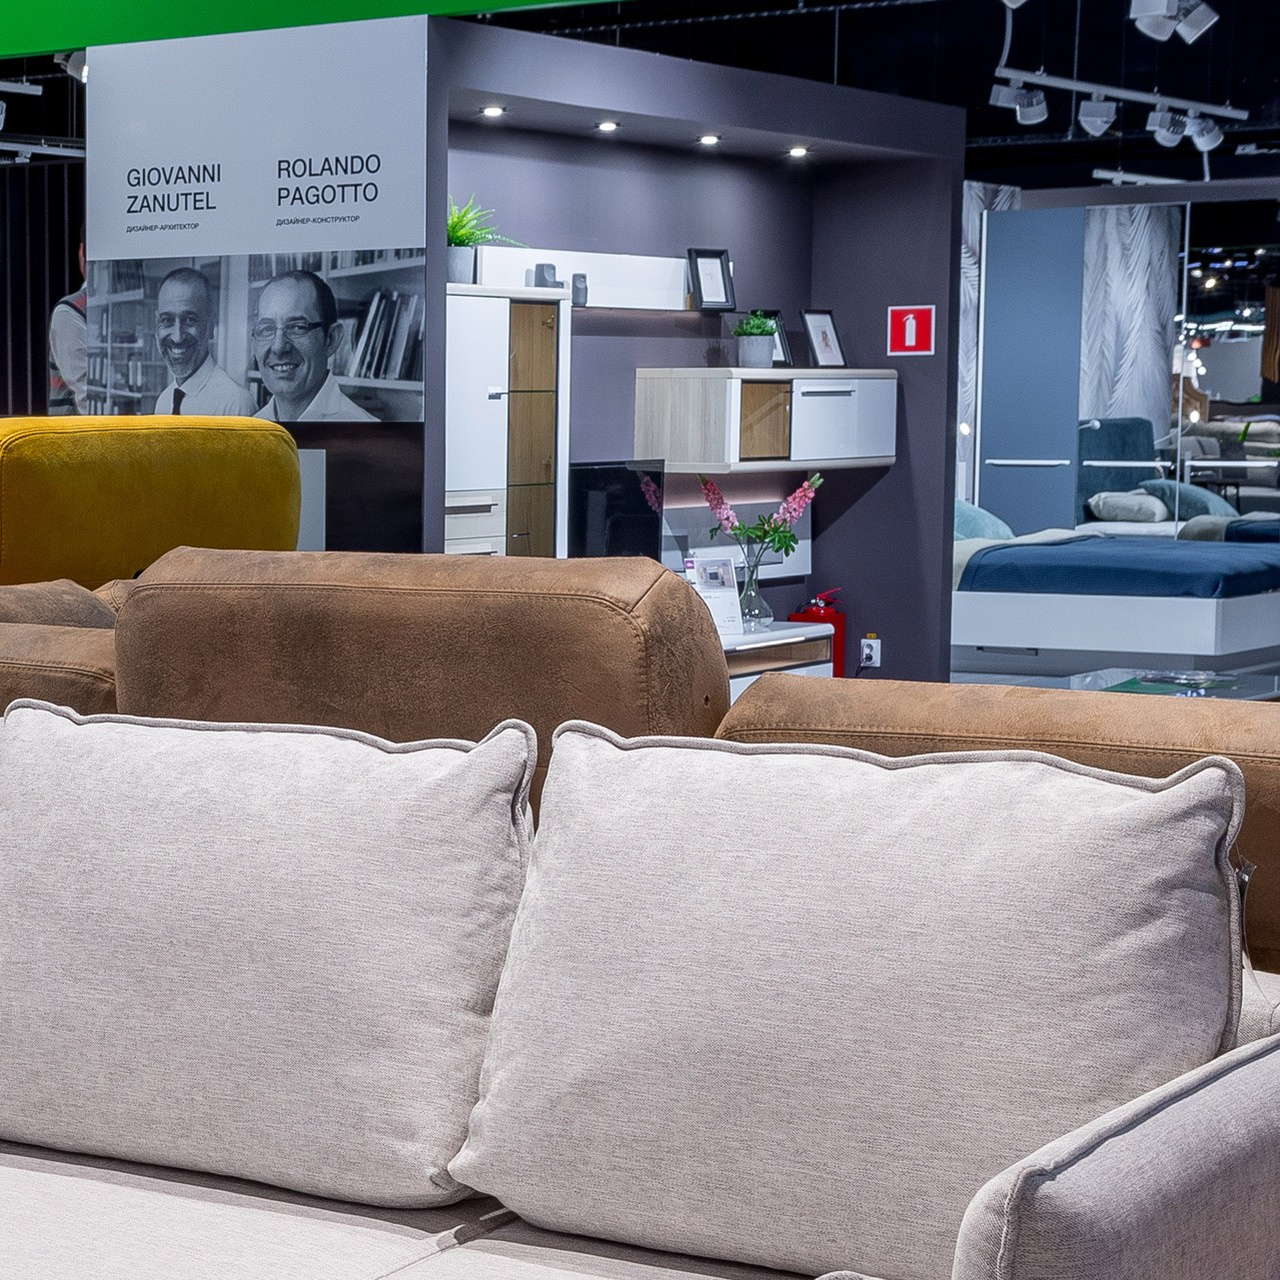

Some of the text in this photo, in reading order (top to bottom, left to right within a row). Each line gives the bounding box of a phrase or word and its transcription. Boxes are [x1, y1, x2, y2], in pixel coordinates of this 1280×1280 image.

[126, 163, 221, 188] GIOVANNI
[277, 154, 381, 179] ROLANDO
[126, 191, 217, 214] ZANUTEL
[277, 182, 379, 206] PAGOTTO
[126, 222, 200, 234] ДИЗАЙНЕР-АРХИТЕКТОР
[276, 215, 360, 227] ДИЗАЙНЕР-КОНСТРУКТОР
